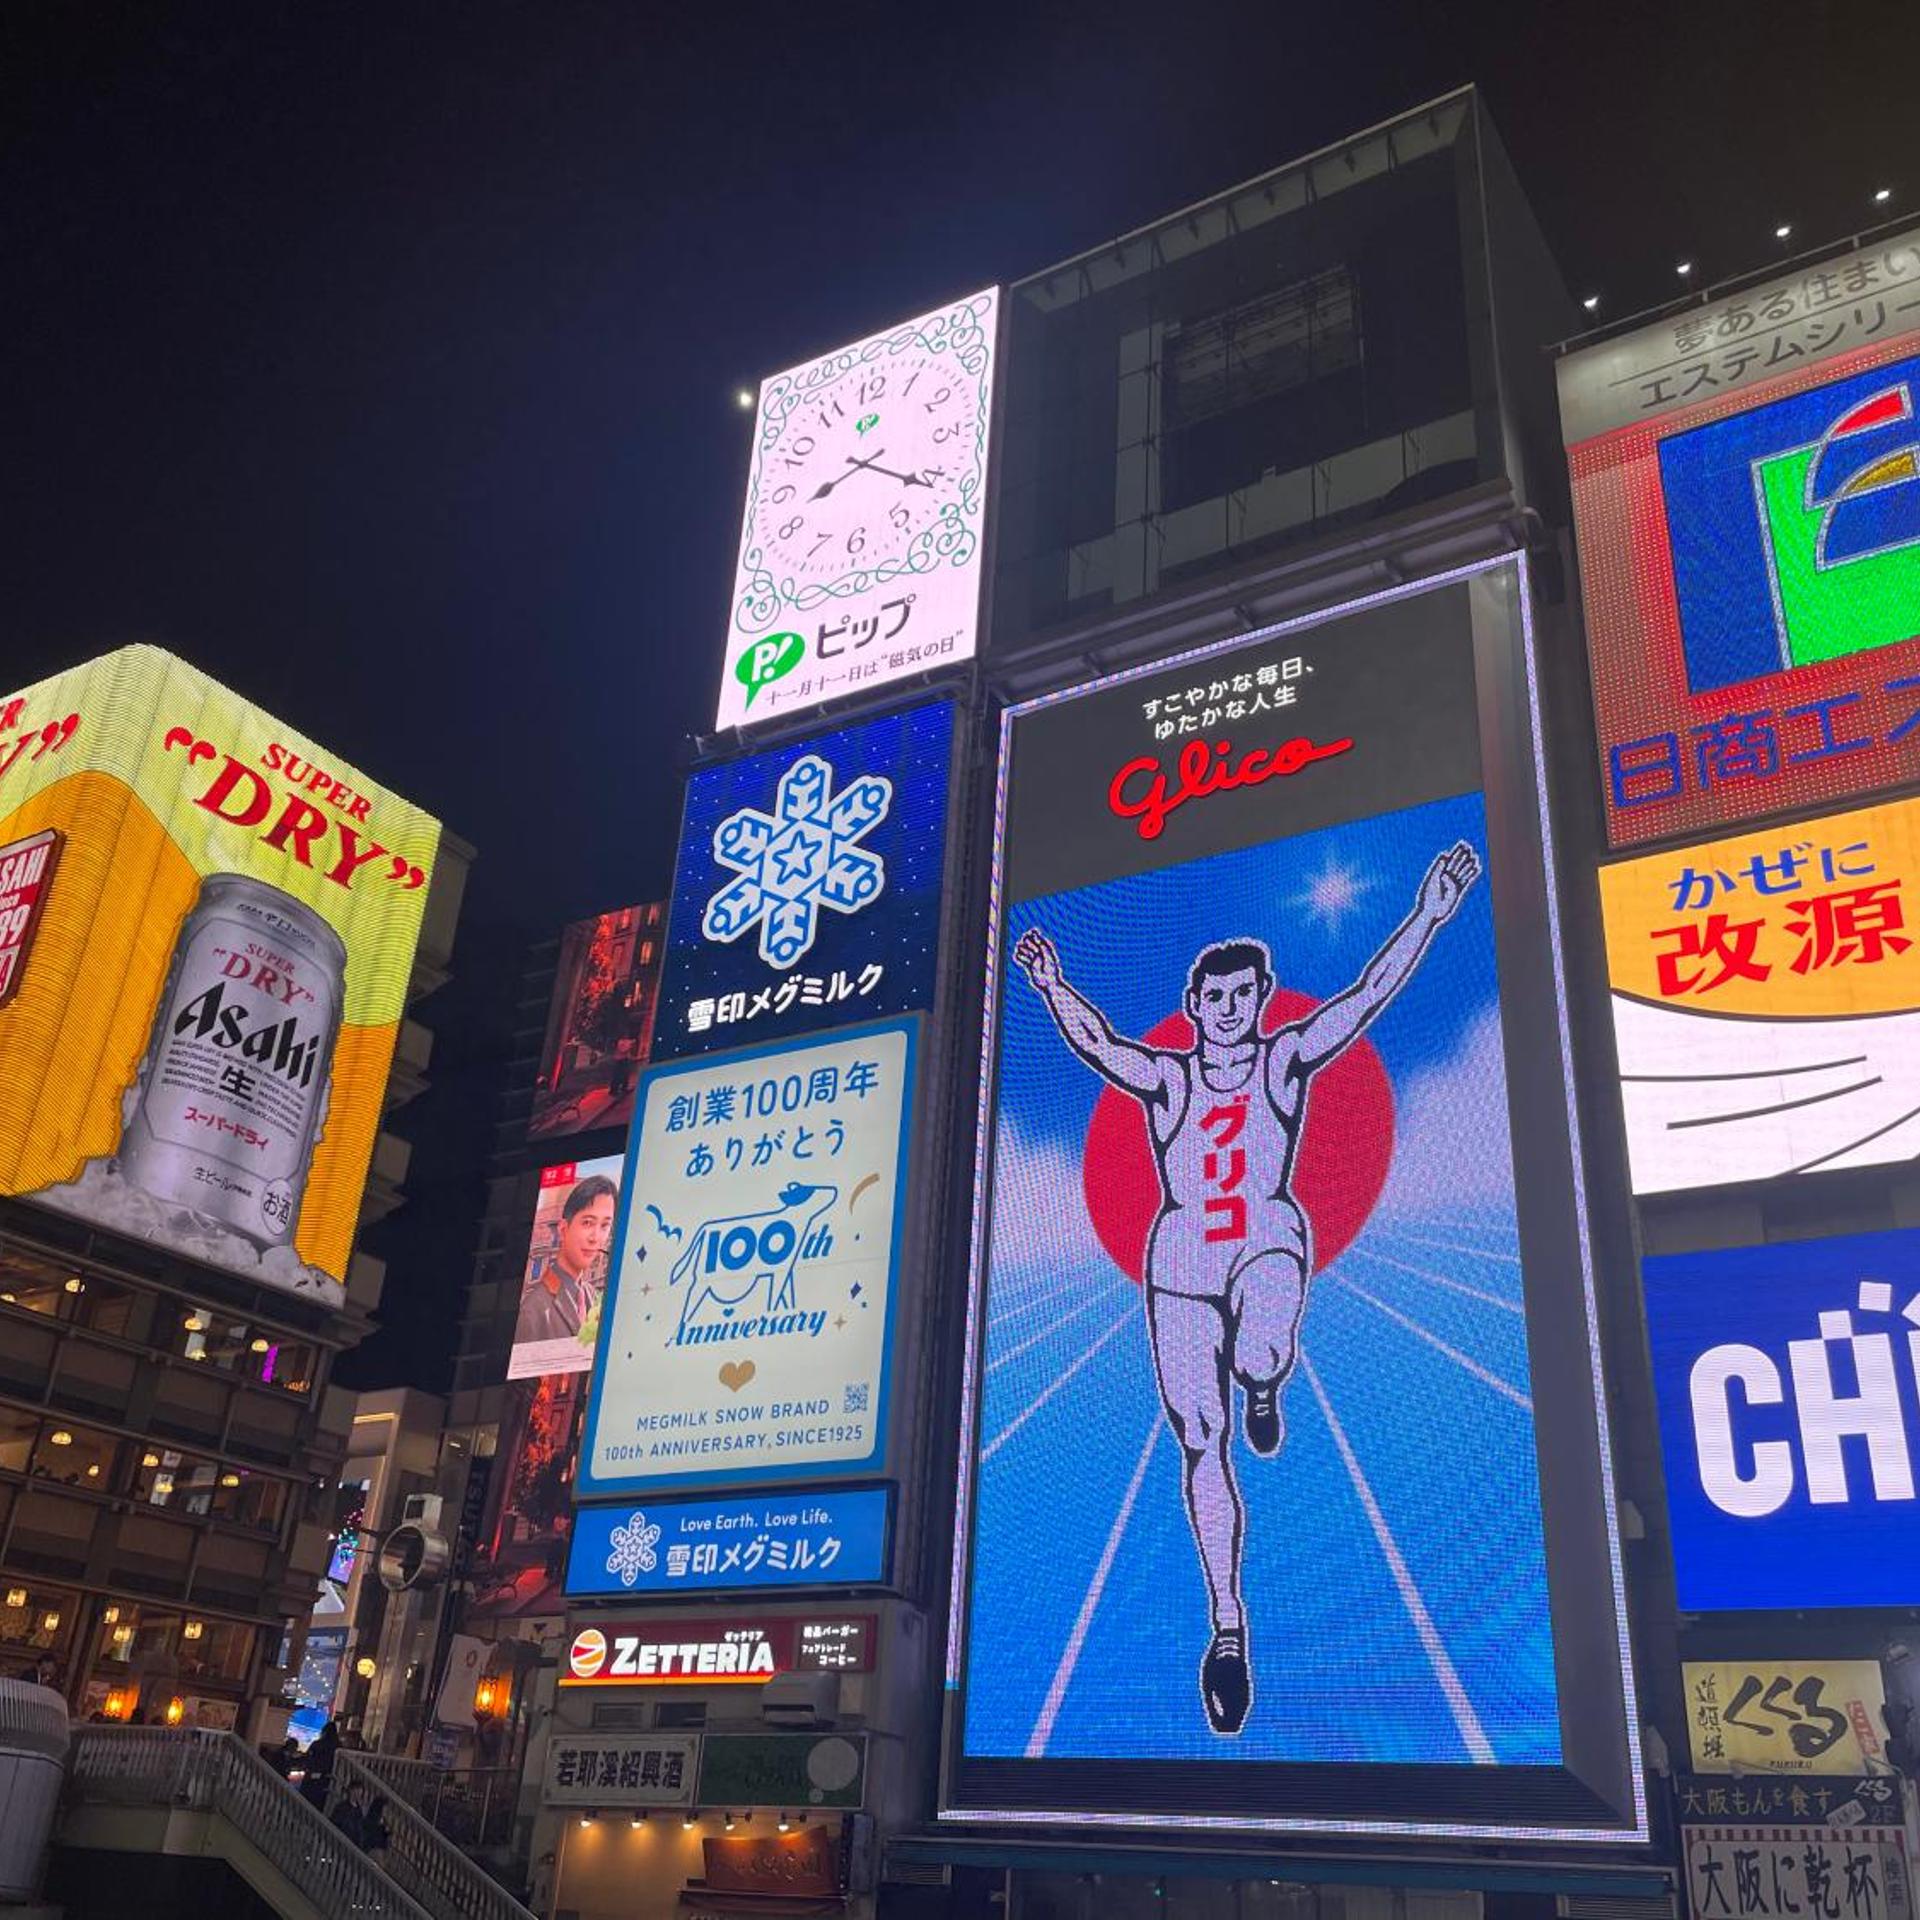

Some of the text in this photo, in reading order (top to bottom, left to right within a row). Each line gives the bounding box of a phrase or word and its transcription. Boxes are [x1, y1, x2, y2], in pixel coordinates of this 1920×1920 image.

[858, 375, 886, 406] 12
[902, 372, 919, 397] 1
[924, 387, 951, 413] 2
[818, 400, 845, 429] 11
[932, 423, 960, 444] 3
[784, 436, 816, 471] 10
[772, 484, 797, 504] 9
[922, 465, 946, 488] 4
[778, 516, 804, 540] 8
[889, 502, 910, 528] 5
[806, 532, 834, 558] 7
[846, 527, 866, 553] 6
[816, 594, 917, 659] ピップ
[1142, 656, 1314, 720] すこやかな毎日、
[1154, 685, 1297, 740] ゆたかな人生
[260, 742, 373, 824] SUPER
[1667, 841, 1876, 911] かぜに
[1650, 878, 1914, 997] 改源
[246, 942, 296, 975] SUPER
[688, 963, 883, 1032] 雪印メグミルク
[174, 980, 320, 1089] Asahi
[219, 1065, 256, 1101] 生
[664, 1060, 880, 1134] 創業100周年
[184, 1106, 269, 1150] スーパードライ
[685, 1118, 850, 1178] ありがとう
[1199, 1094, 1252, 1243] グリコ
[664, 1306, 828, 1348] Anniversary
[636, 1399, 830, 1431] MEGMILK SNOW BRAND
[605, 1445, 644, 1461] 100th
[680, 1508, 833, 1533] Love Earth. Love Life.
[666, 1534, 842, 1577] 雪印メグミルク
[609, 1637, 775, 1675] ZETTERIA
[1723, 1675, 1848, 1758] くくる
[1700, 1843, 1879, 1920] 大阪に乾杯
